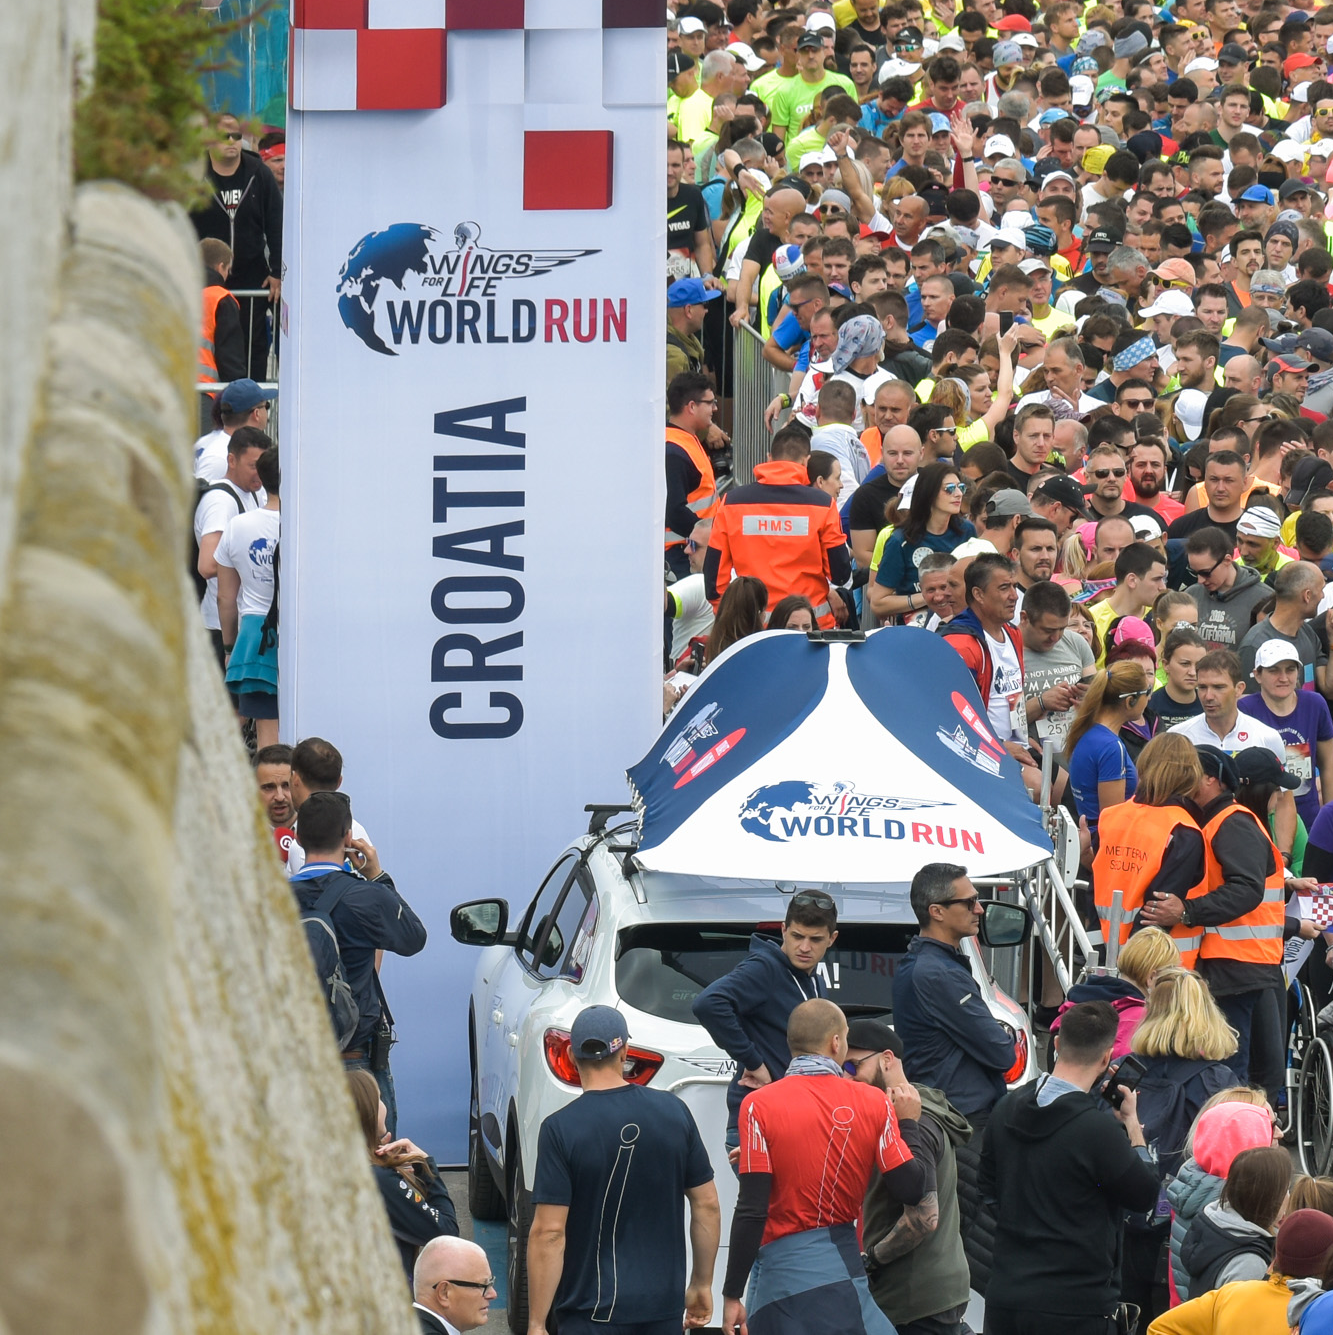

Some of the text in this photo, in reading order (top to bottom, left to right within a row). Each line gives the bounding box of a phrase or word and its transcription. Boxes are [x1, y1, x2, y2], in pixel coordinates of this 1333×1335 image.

[668, 221, 690, 231] VEGAS
[426, 253, 533, 277] WINGS
[421, 276, 503, 298] FOR LIFE
[386, 298, 628, 346] WORLD RUN
[758, 519, 794, 533] HMS
[428, 395, 528, 741] CROATIA
[1030, 671, 1045, 679] NOT
[810, 795, 900, 809] WINGS
[825, 806, 872, 817] LIFE
[780, 816, 986, 855] WORLD RUN
